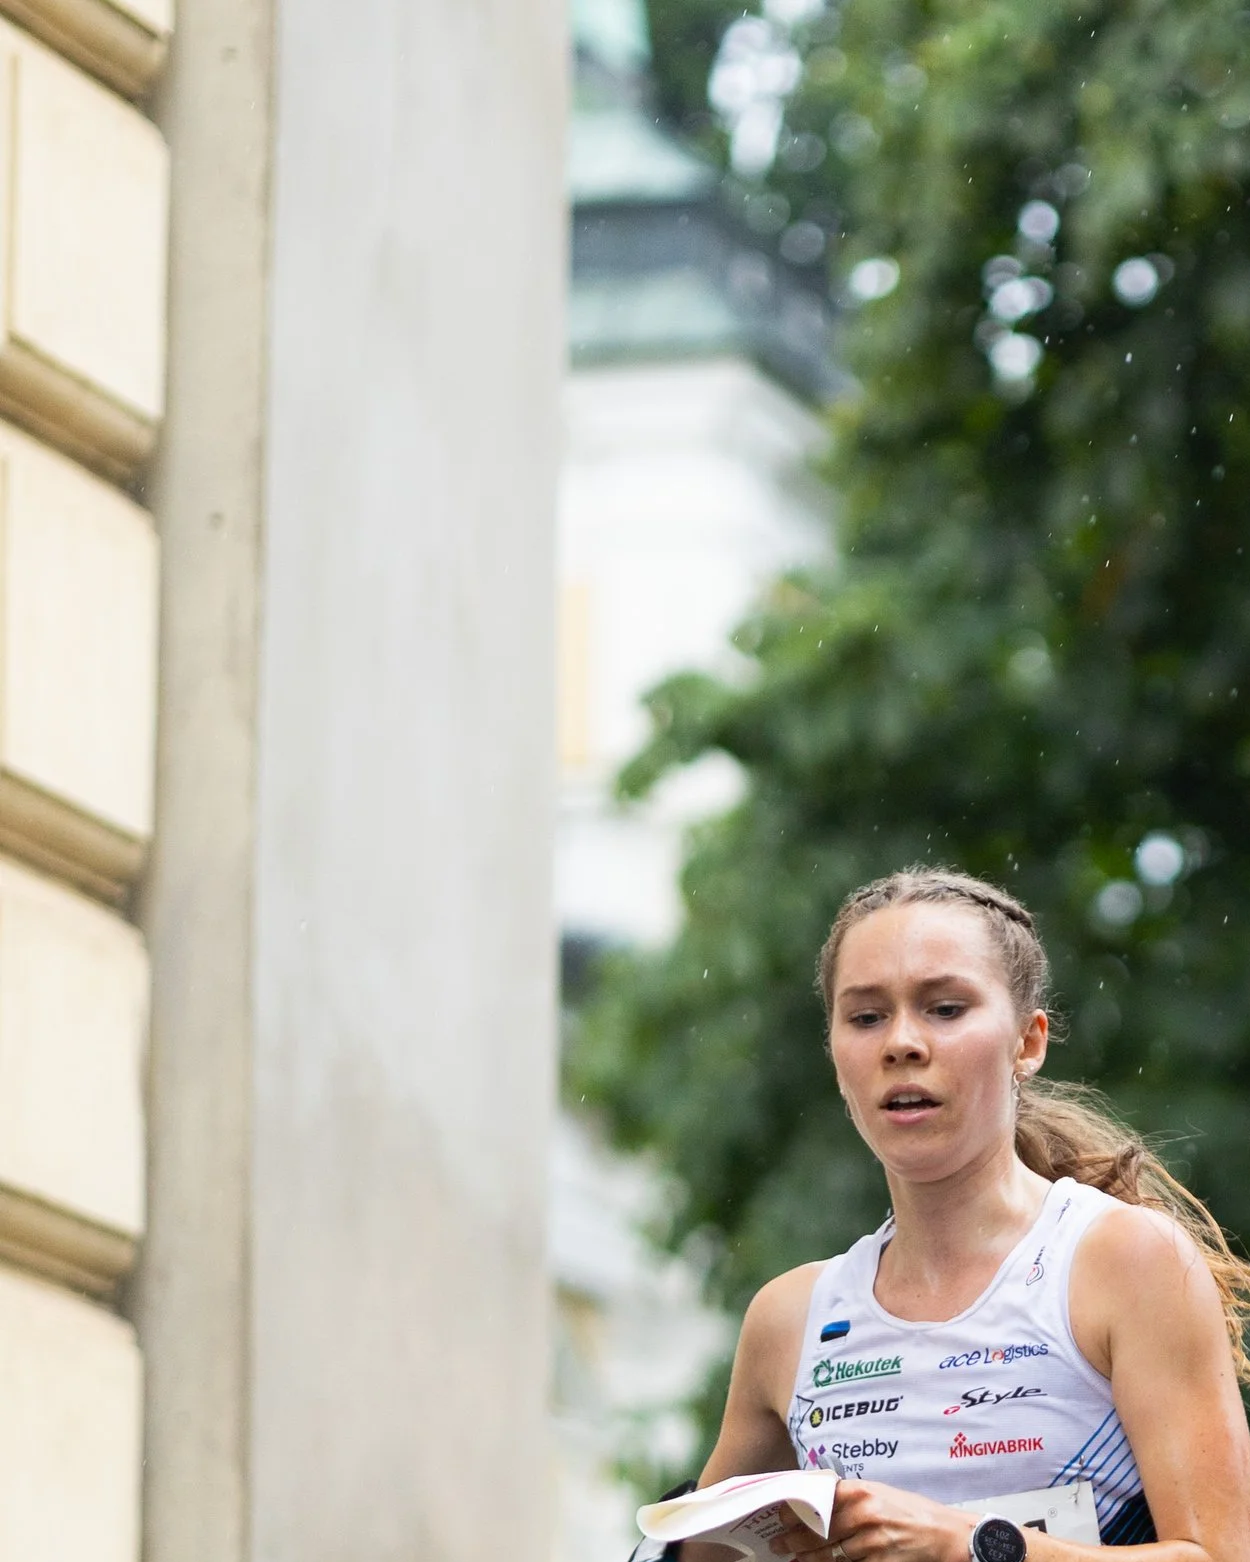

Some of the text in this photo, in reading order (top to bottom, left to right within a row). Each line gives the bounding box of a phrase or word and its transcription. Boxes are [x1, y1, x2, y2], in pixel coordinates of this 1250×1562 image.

[835, 1355, 904, 1380] Hekotek
[939, 1343, 1049, 1369] ace Logistics
[825, 1395, 903, 1422] ICEBUG
[831, 1438, 899, 1459] Stebby
[950, 1437, 1044, 1459] KINGIVABRIK
